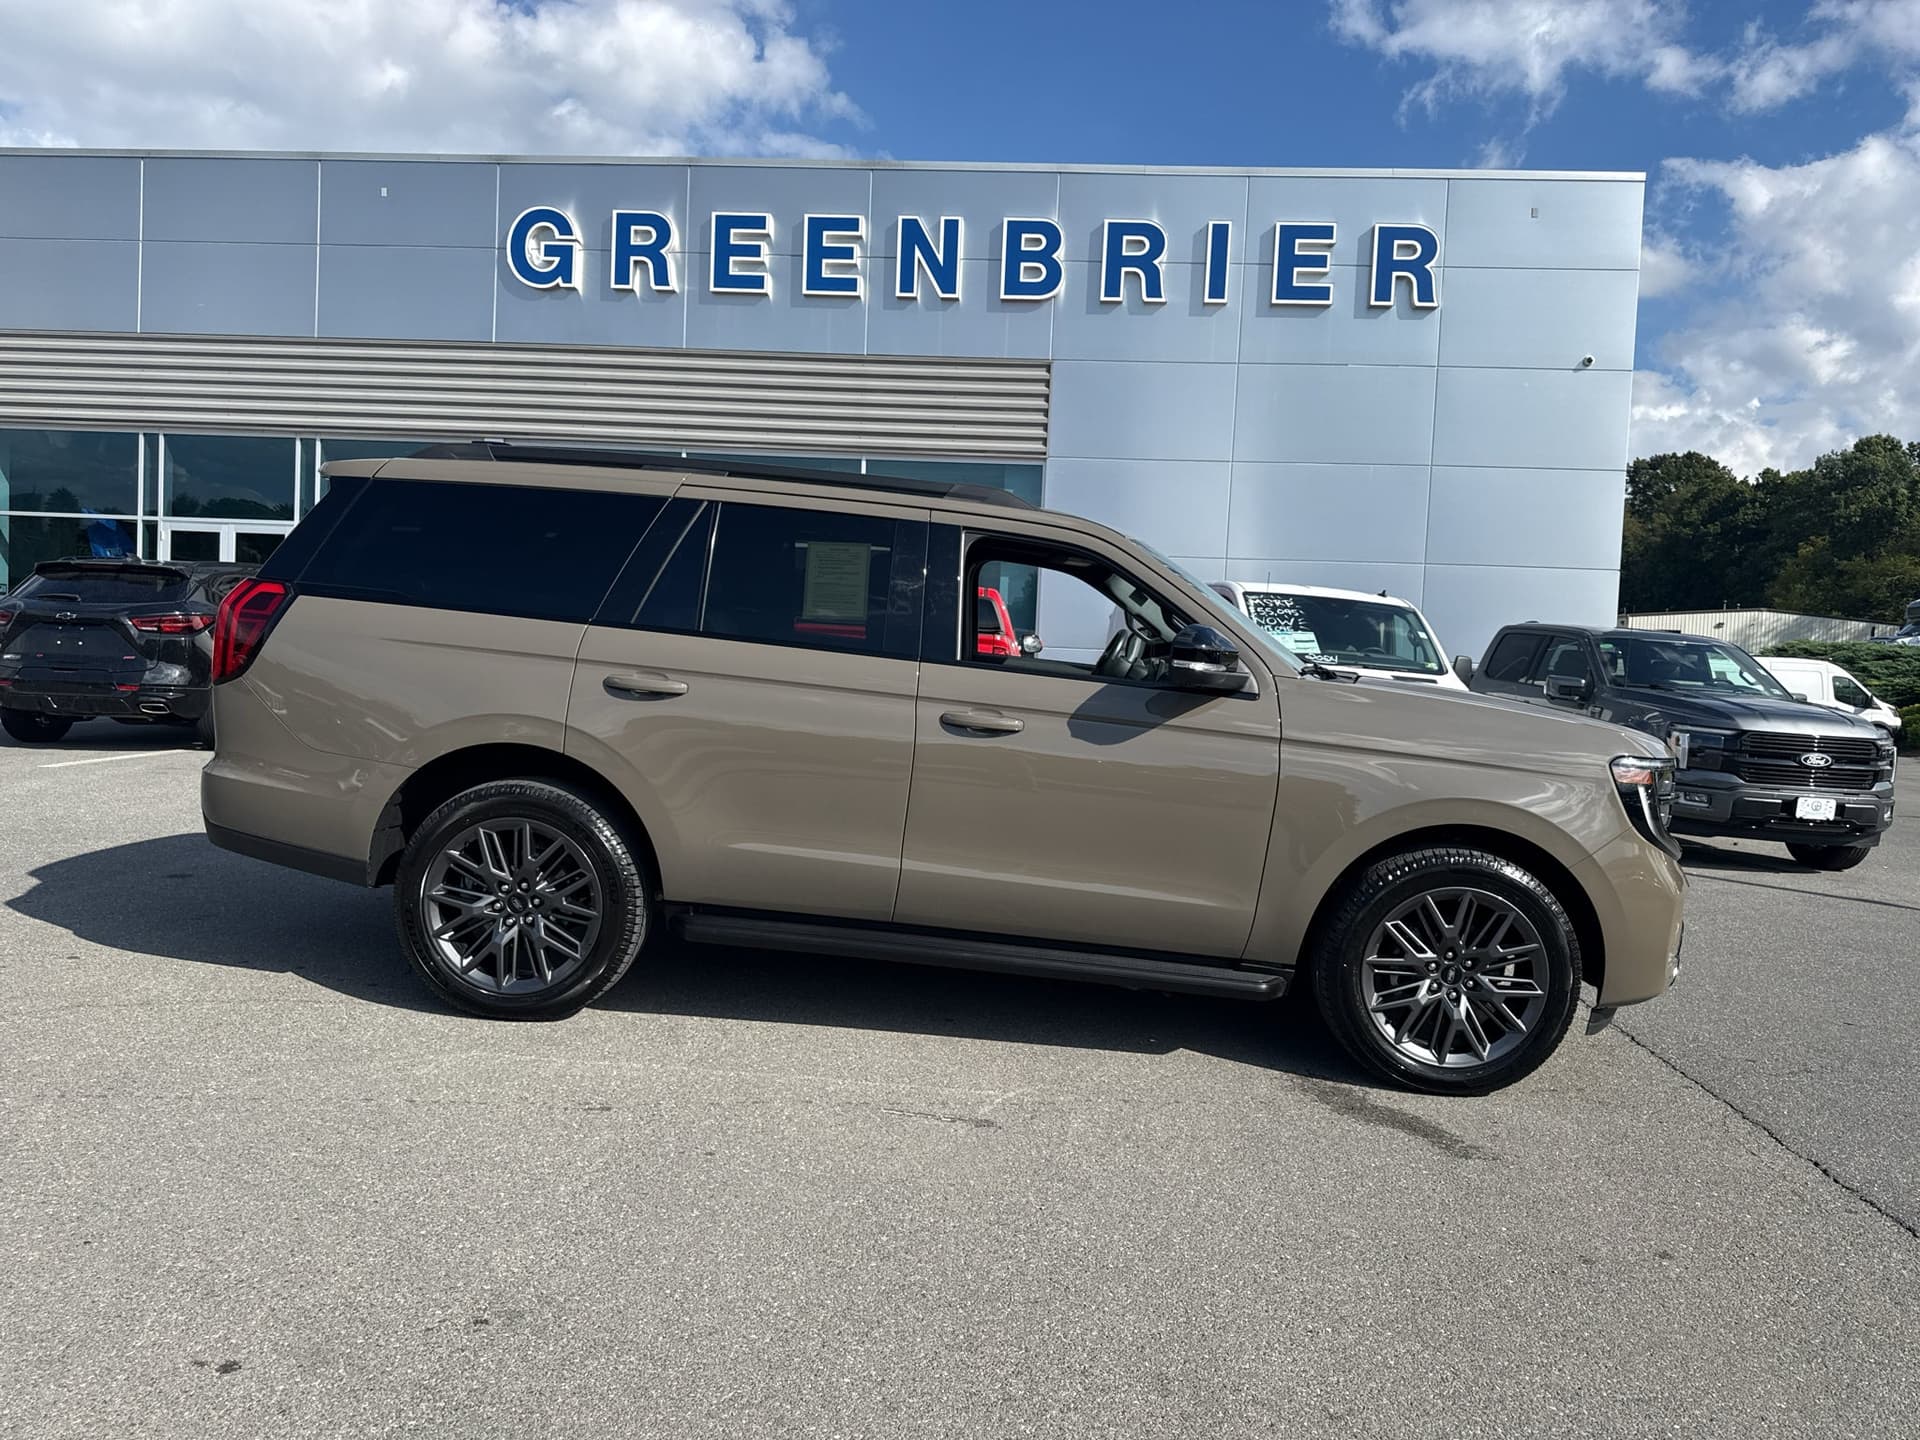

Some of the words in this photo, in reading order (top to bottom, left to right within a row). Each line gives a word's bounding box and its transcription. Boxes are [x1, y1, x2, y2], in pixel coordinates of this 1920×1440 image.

[505, 206, 1440, 310] GREENBRIER
[1254, 598, 1294, 608] MSRP
[1254, 616, 1295, 626] NOW
